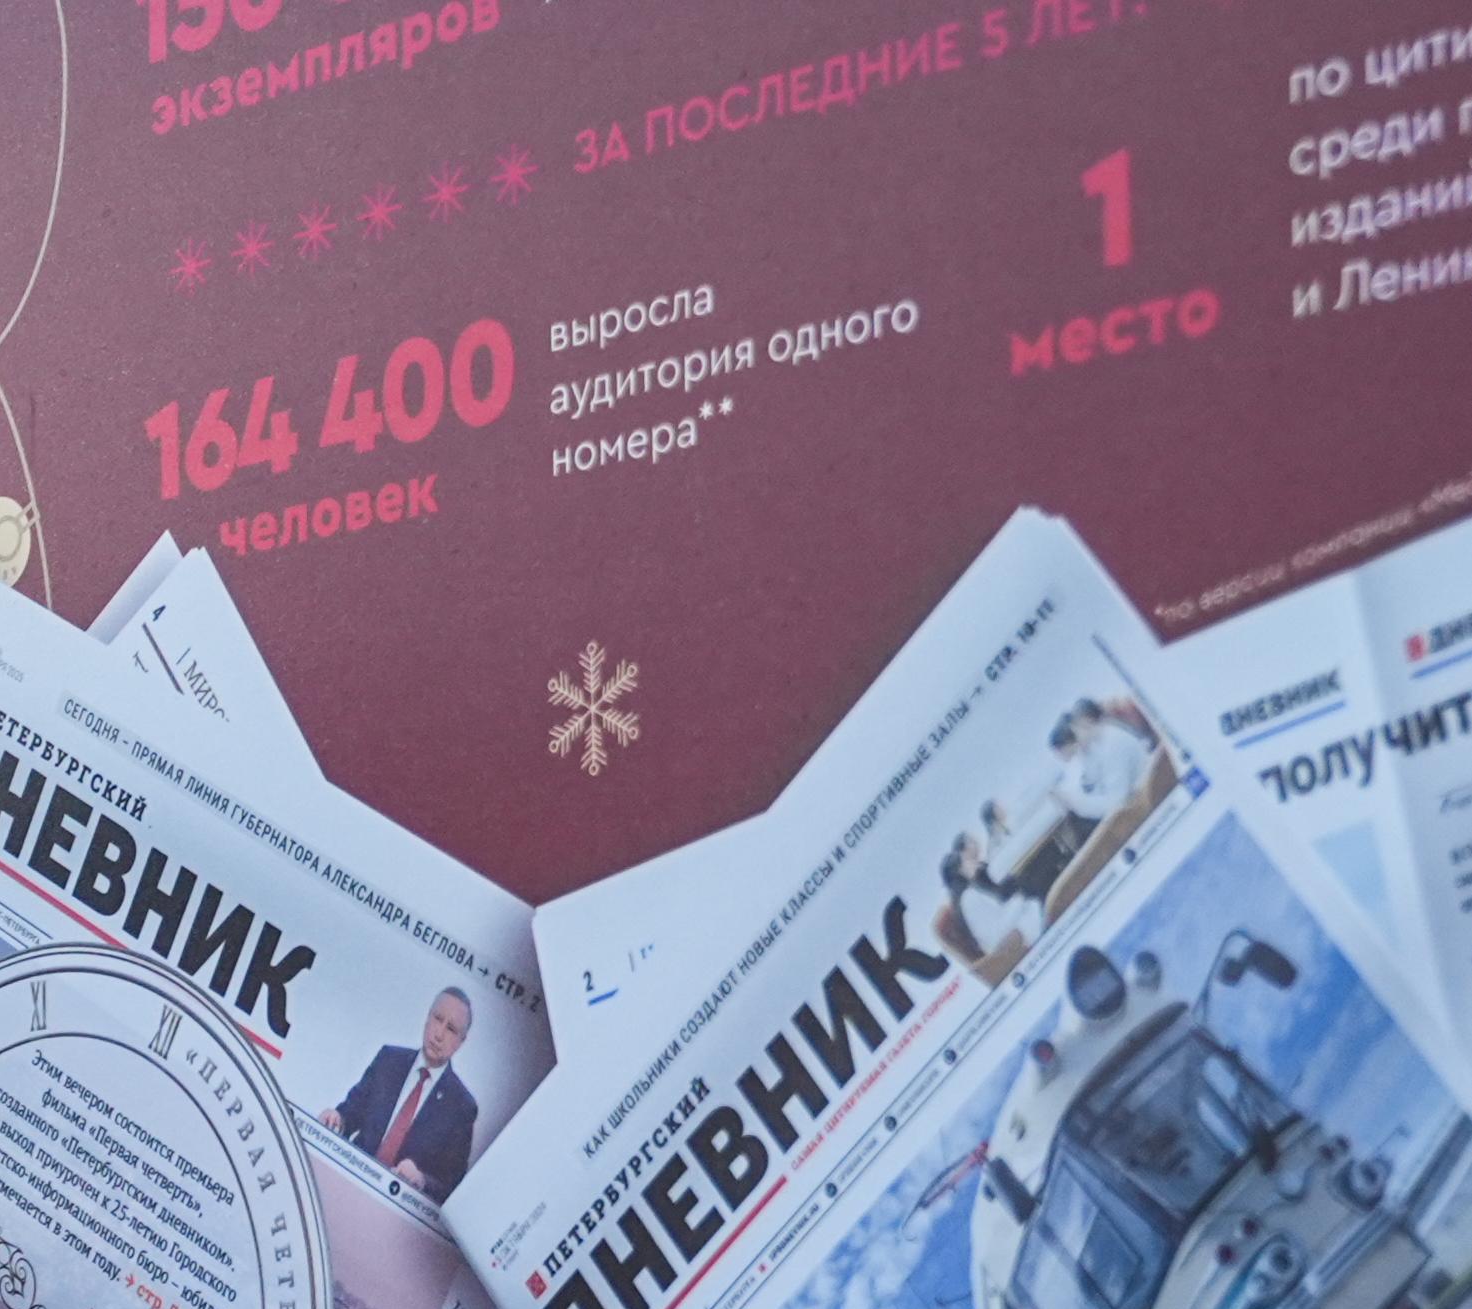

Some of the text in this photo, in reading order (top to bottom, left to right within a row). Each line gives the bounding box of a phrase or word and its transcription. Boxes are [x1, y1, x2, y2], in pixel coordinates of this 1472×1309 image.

[151, 0, 501, 135] экземпляров
[574, 121, 630, 172] ЗА
[645, 21, 965, 154] ПОСЛЕДНИЕ
[982, 4, 1009, 58] 5
[1289, 56, 1353, 104] по
[1289, 105, 1445, 180] среди
[1080, 147, 1133, 268] 1
[549, 283, 716, 353] выросла
[549, 297, 920, 416] аудитория одного
[1008, 287, 1221, 377] место
[1292, 279, 1323, 319] и
[143, 317, 515, 501] 164 400
[219, 472, 439, 557] человек
[59, 697, 122, 745] СЕГОДНЯ
[128, 741, 187, 785] ПРЯМАЯ
[182, 775, 231, 813] ЛИНИЯ
[227, 804, 322, 871] ГУБЕРНАТОРА
[317, 862, 415, 932] АЛЕКСАНДРА
[409, 920, 479, 971] БЕГЛОВА
[579, 1124, 612, 1159] КАК
[604, 1040, 684, 1130] ШКОЛЬНИКИ
[675, 971, 742, 1046] СОЗДАЮТ
[733, 920, 784, 976] НОВЫЕ
[775, 857, 837, 926] КЛАССЫ
[828, 845, 847, 864] И
[839, 743, 934, 850] СПОРТИВНЫЕ
[925, 699, 972, 750] ЗАЛЫ
[29, 1049, 237, 1208] Этим вечером состоится премьера
[37, 1087, 209, 1219] фильма «Первая четверть»,
[541, 1073, 712, 1277] ПЕТЕРБУРГСКИЙ
[32, 1148, 102, 1204] приурочен
[98, 1194, 112, 1210] к
[106, 1199, 172, 1252] 25-летию
[162, 1242, 245, 1308] Городского
[51, 1222, 64, 1235] в
[60, 1229, 94, 1258] этом
[89, 1251, 126, 1284] году.
[55, 1131, 162, 1215] «Петербургским
[155, 1206, 240, 1272] дневником».
[130, 1250, 173, 1288] бюро
